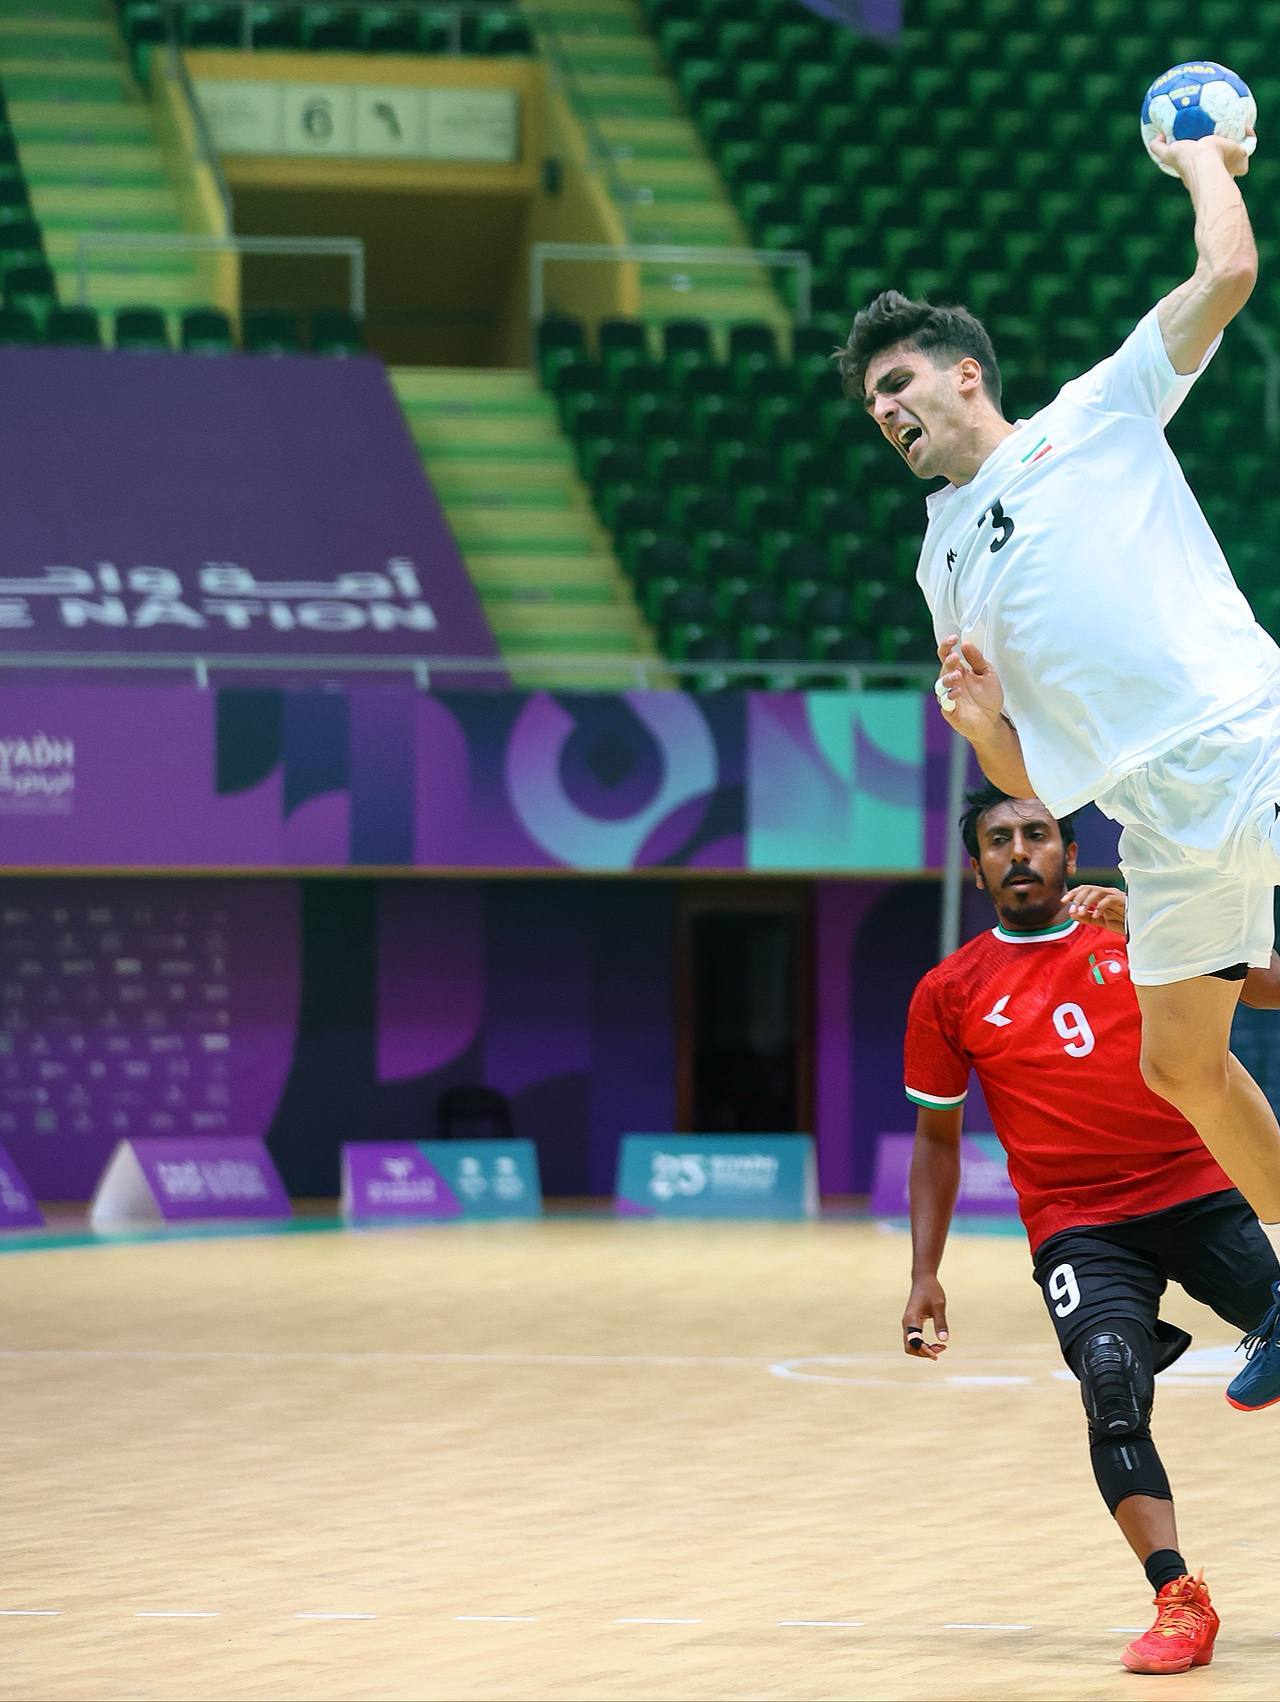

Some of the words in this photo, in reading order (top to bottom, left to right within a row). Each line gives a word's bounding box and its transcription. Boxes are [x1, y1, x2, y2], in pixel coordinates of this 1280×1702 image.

[977, 499, 1015, 553] 3
[61, 597, 437, 631] NATION
[0, 732, 75, 769] YADH
[1052, 1002, 1095, 1058] 9
[1048, 1263, 1081, 1318] 9
